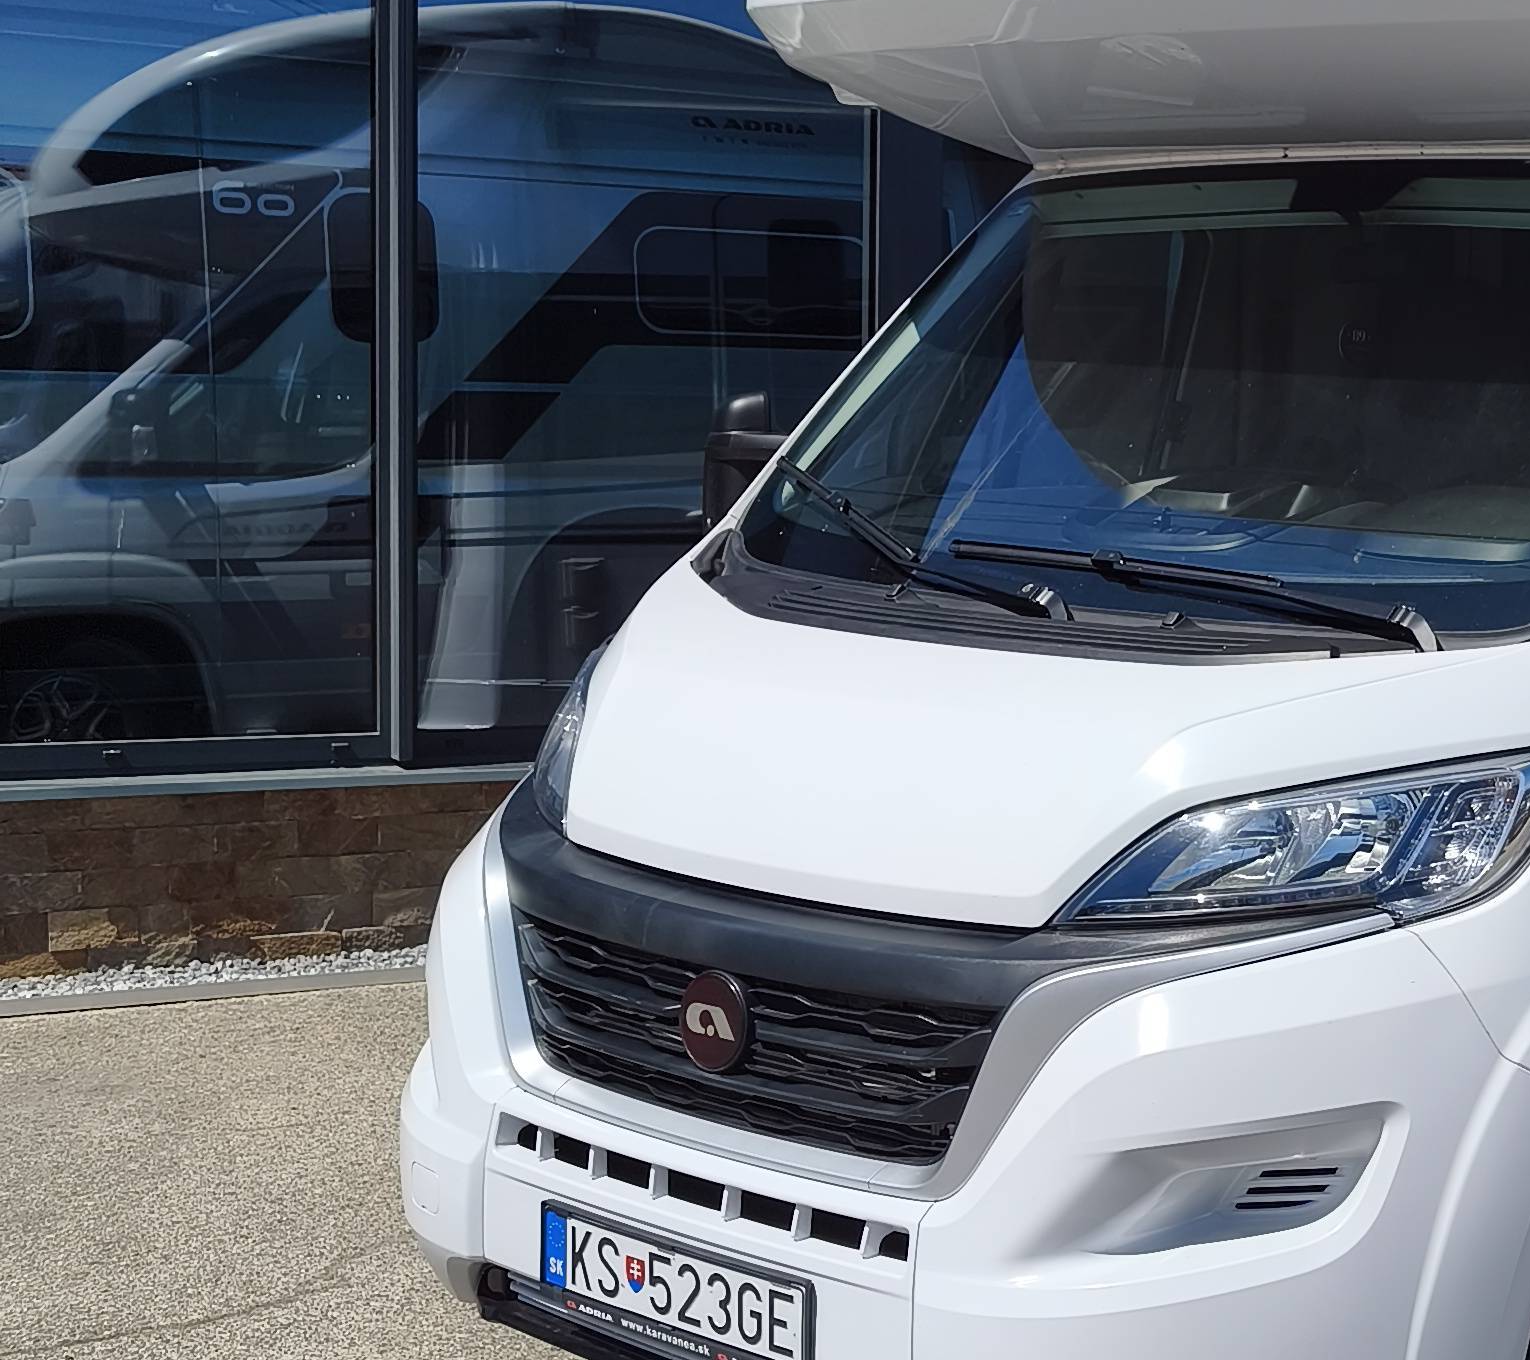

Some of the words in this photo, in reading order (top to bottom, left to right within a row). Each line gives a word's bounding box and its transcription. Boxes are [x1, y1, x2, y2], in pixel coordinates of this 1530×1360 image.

[722, 118, 815, 136] ADRIA
[212, 179, 295, 217] 60
[549, 1256, 565, 1277] SK
[570, 1225, 620, 1298] KS
[648, 1251, 795, 1358] 523GE
[578, 1304, 614, 1323] ADRIA
[620, 1317, 711, 1357] www.karavanea.sk
